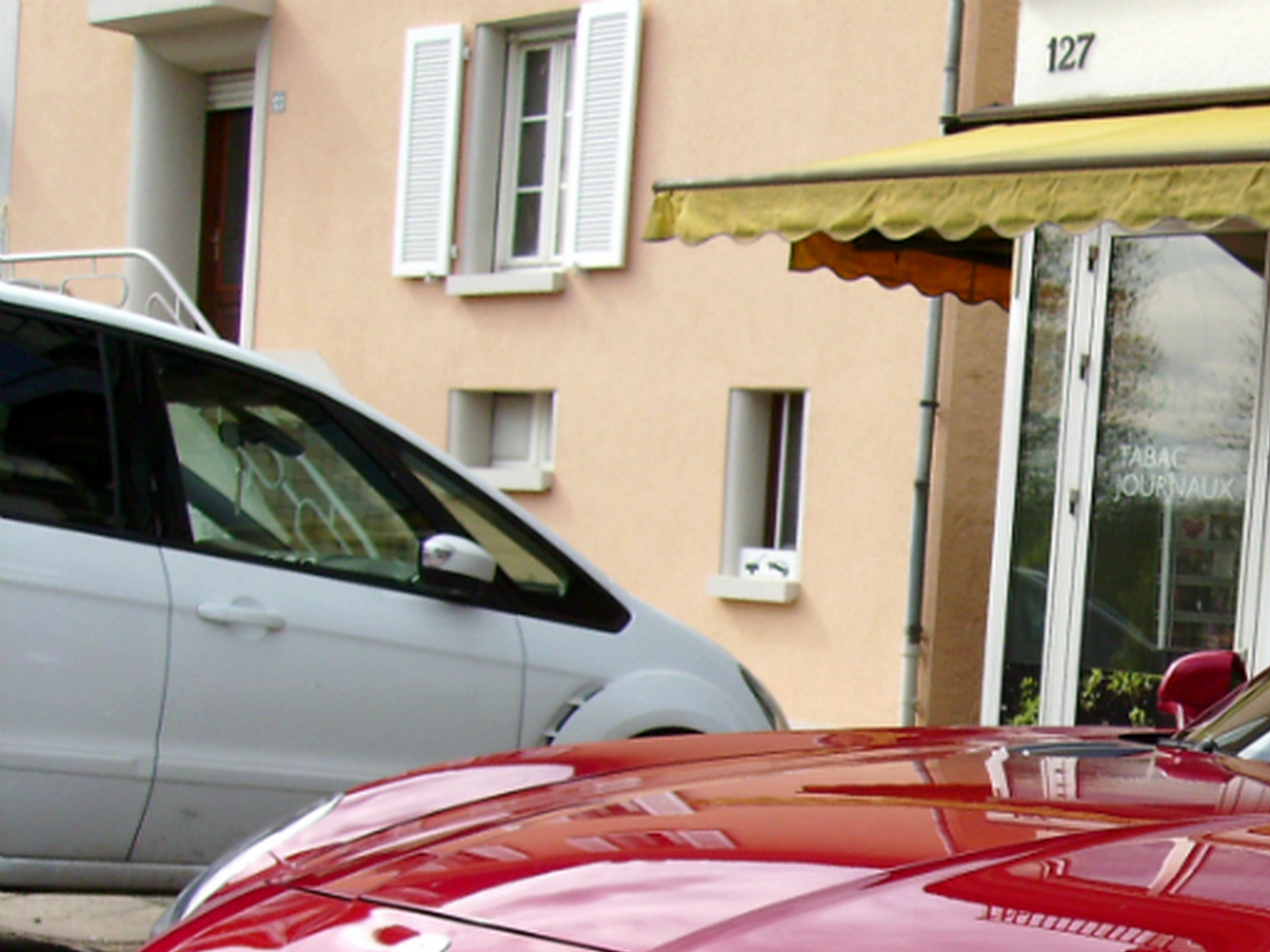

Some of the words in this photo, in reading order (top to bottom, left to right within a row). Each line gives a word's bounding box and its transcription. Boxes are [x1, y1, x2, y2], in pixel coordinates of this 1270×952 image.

[1046, 32, 1096, 73] 127
[1119, 444, 1188, 470] TABAC
[1113, 473, 1235, 503] JOURNAUX
